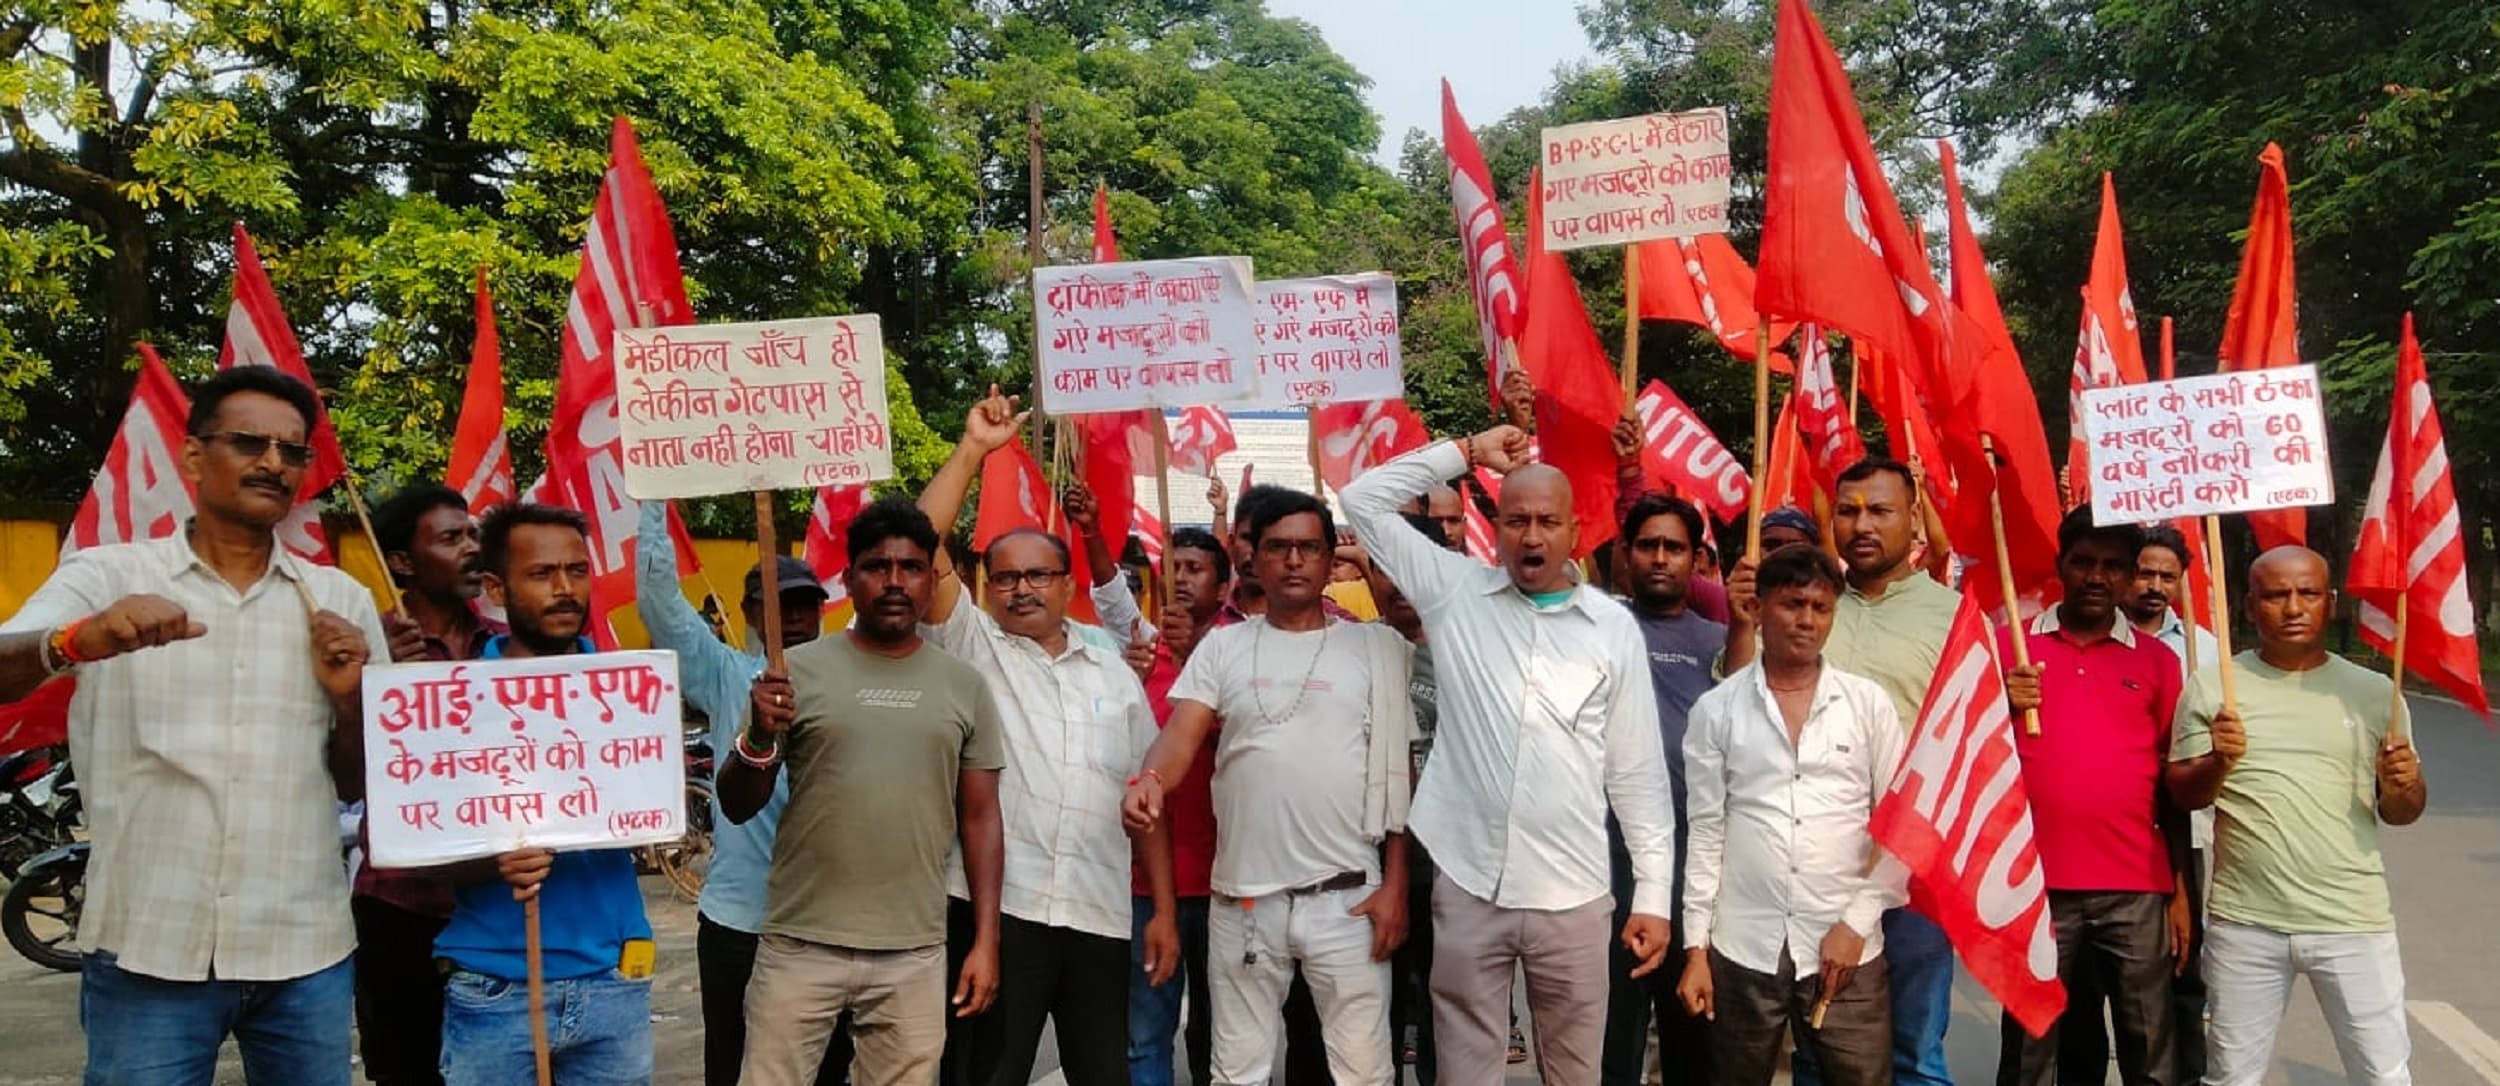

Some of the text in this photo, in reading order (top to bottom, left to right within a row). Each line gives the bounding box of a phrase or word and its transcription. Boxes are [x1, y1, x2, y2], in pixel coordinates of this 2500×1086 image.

[1551, 217, 1579, 240] पर
[1585, 207, 1647, 234] वापस
[1649, 193, 1675, 225] लो
[621, 333, 731, 375] मेडीकल
[831, 321, 864, 369] हो
[1053, 368, 1099, 394] काम
[1104, 366, 1132, 390] पर
[1138, 360, 1204, 387] वापस
[1204, 347, 1236, 384] लो
[1273, 352, 1299, 373] पर
[1311, 348, 1363, 372] वापस
[1367, 340, 1390, 369] लो
[626, 371, 866, 425] लेकीन गेटपास से
[2158, 383, 2186, 414] के
[2192, 376, 2249, 409] सभी
[628, 435, 689, 468] नाता
[745, 425, 800, 466] होना
[2208, 412, 2246, 441] को
[2102, 434, 2318, 483] वर्ष नौकरी की
[2109, 476, 2186, 513] गारंटी
[2194, 472, 2254, 506] करो
[386, 738, 425, 785] के
[545, 729, 588, 772] को
[600, 733, 666, 770] काम
[398, 800, 444, 831] पर
[455, 792, 547, 828] वापस
[558, 775, 605, 817] लो
